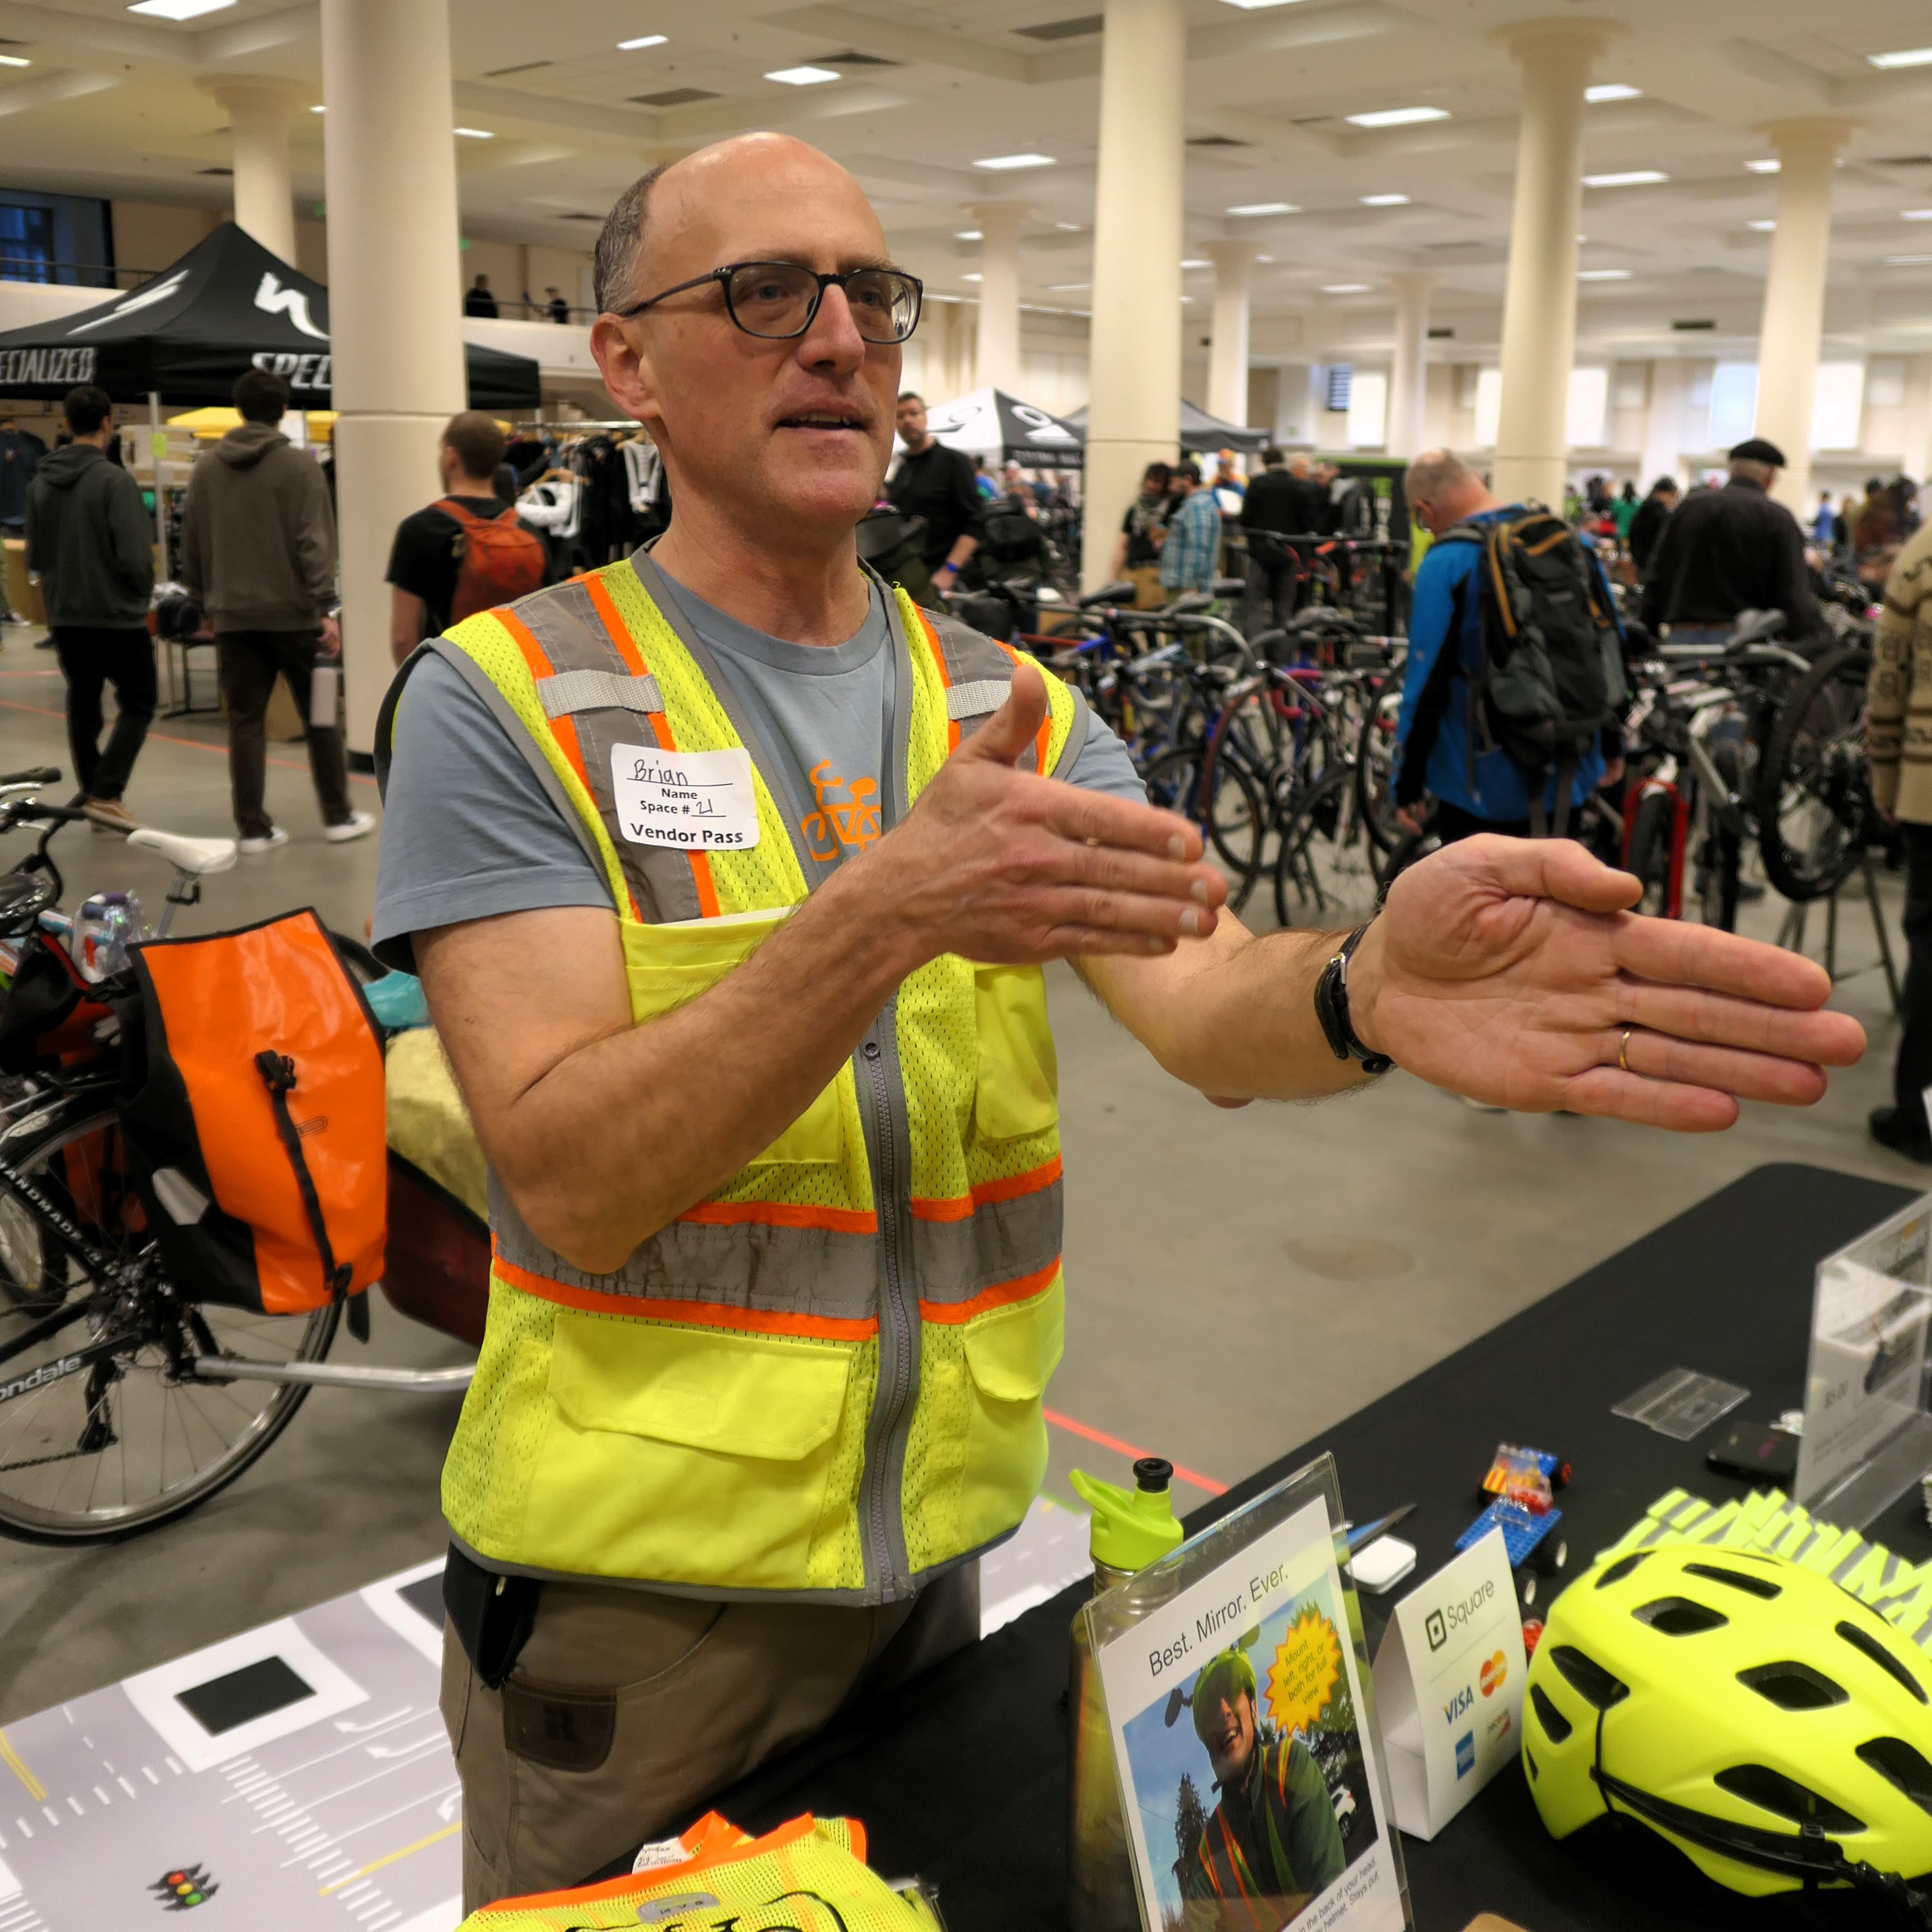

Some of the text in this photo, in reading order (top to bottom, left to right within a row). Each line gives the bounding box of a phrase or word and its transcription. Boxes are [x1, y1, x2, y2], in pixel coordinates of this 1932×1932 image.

[634, 759, 688, 786] Brian
[640, 799, 713, 815] Space # 21
[661, 788, 697, 799] Name
[630, 823, 744, 843] Vendor Pass
[1149, 1564, 1288, 1677] Best. Mirror. Ever.
[1447, 1580, 1495, 1629] Square
[1283, 1642, 1325, 1688] left, right, or
[1285, 1639, 1309, 1668] Mount
[1288, 1657, 1328, 1701] both for full
[1303, 1685, 1319, 1705] view
[1442, 1684, 1474, 1724] VISA
[1306, 1915, 1319, 1930] the
[1318, 1897, 1336, 1919] back
[1336, 1888, 1343, 1901] of
[1344, 1875, 1358, 1897] your
[1350, 1883, 1368, 1906] Stays
[1368, 1871, 1381, 1889] put.
